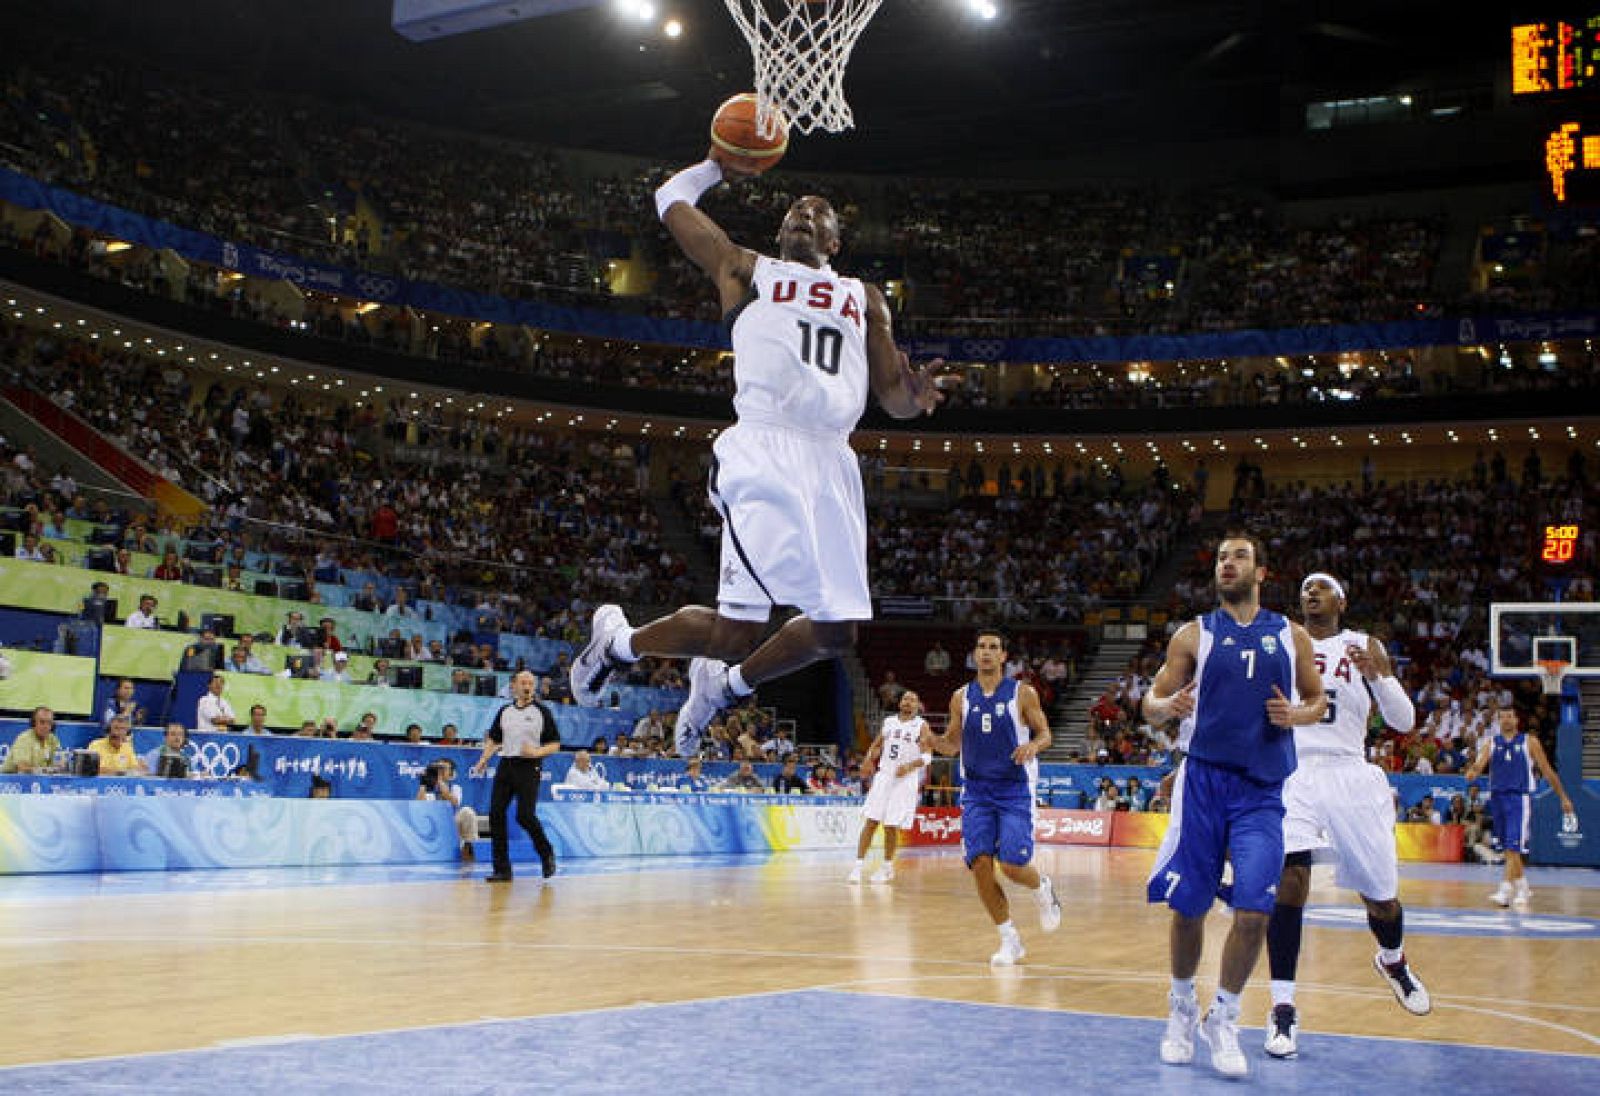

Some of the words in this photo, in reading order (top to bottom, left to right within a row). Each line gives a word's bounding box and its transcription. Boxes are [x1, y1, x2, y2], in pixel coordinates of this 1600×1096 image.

[772, 280, 861, 329] USA
[797, 319, 843, 376] 10
[1543, 539, 1573, 559] 20
[1240, 650, 1256, 679] 7
[1313, 652, 1352, 683] SA
[889, 744, 900, 760] 5
[1164, 871, 1181, 898] 7
